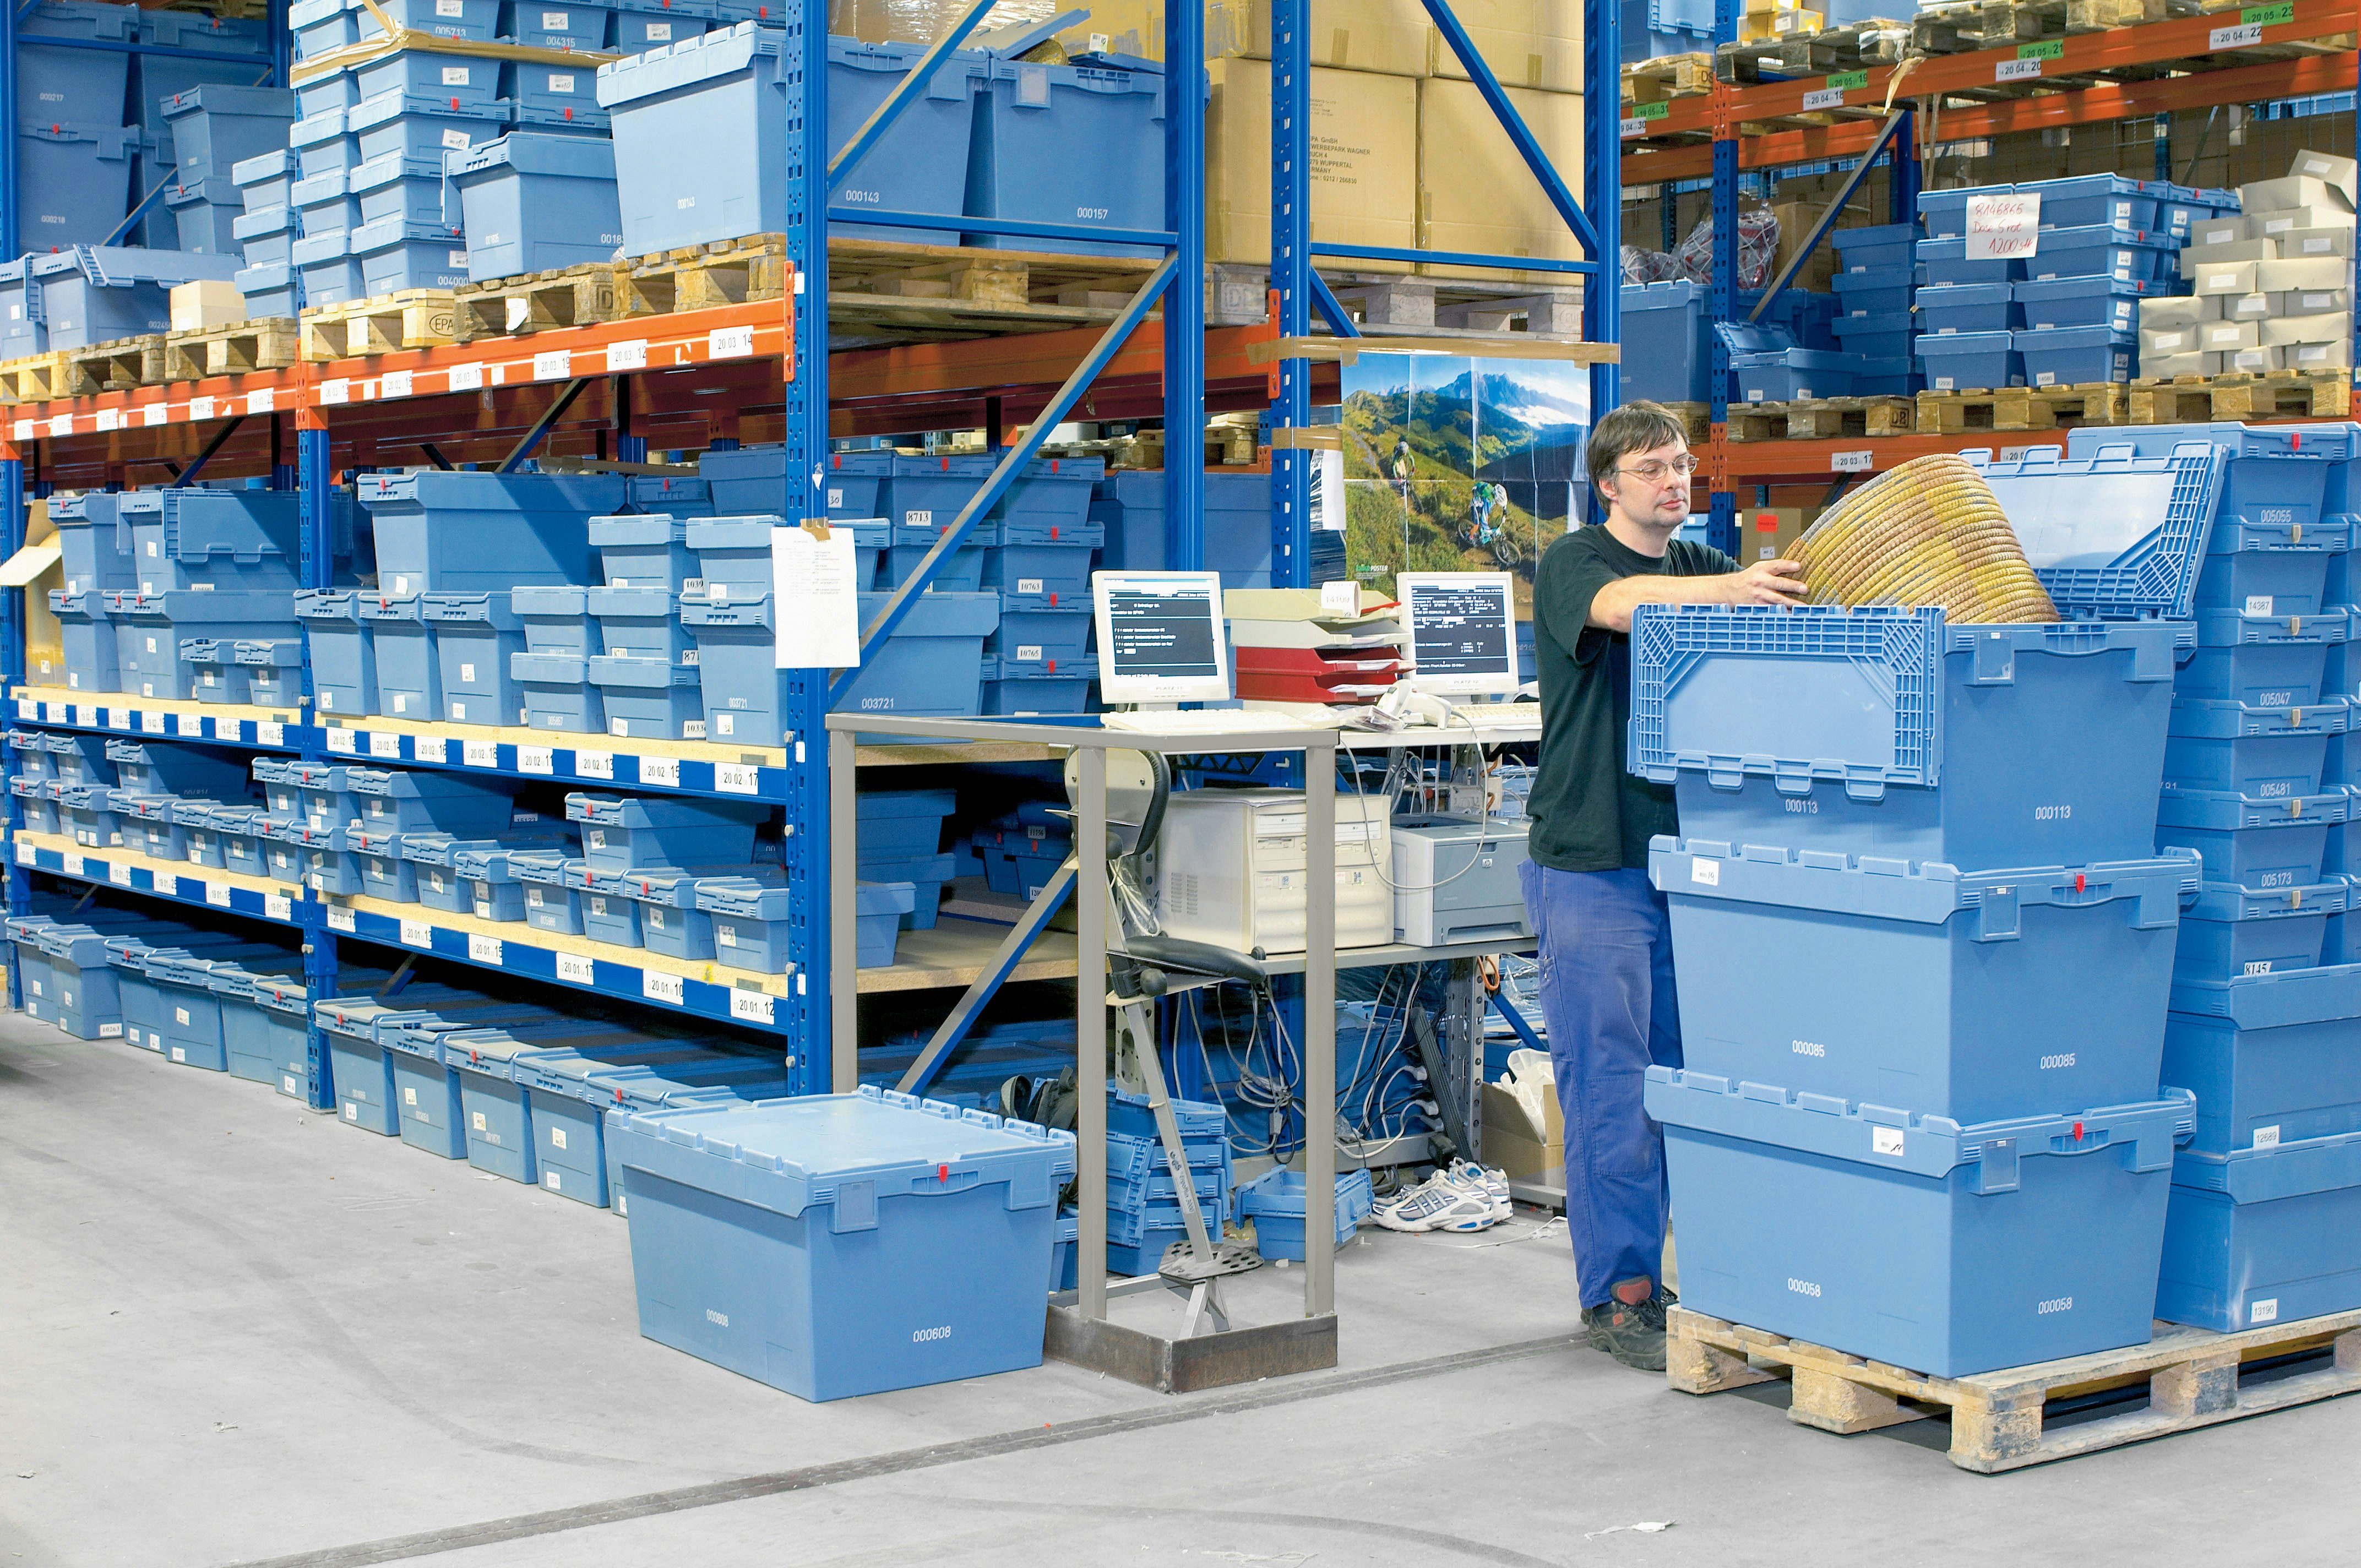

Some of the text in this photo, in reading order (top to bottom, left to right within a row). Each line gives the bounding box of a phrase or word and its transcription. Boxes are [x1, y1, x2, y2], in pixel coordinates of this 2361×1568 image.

[2251, 7, 2293, 22] 20 05 23
[2221, 34, 2230, 42] 20
[2233, 31, 2243, 40] 04
[2250, 26, 2261, 38] 22
[546, 36, 576, 47] 004315
[2027, 43, 2063, 58] 20 05 21
[2005, 61, 2041, 75] 20 04 20
[1811, 96, 1820, 105] 20
[1835, 90, 1844, 100] 18
[1661, 105, 1669, 114] 31
[1638, 120, 1646, 130] 30
[1311, 143, 1370, 155] WERBEPARK WAGNER
[1320, 159, 1353, 168] WUPPERTAL
[845, 190, 880, 203] 000143
[1077, 207, 1109, 220] 000157
[601, 233, 622, 244] 0018
[1989, 237, 2019, 254] 1200
[718, 333, 753, 350] 20 03 14
[616, 346, 646, 362] 20 03 12
[541, 356, 570, 372] 20 03 19
[1863, 454, 1873, 464] 17
[907, 511, 929, 523] 8713
[2261, 509, 2291, 522] 005055
[862, 698, 894, 710] 003721
[2260, 692, 2291, 706] 005047
[383, 741, 389, 750] 02
[421, 744, 427, 754] 20
[429, 745, 434, 755] 02
[471, 749, 477, 759] 20
[478, 749, 485, 759] 02
[526, 755, 532, 765] 20
[534, 756, 540, 766] 02
[584, 758, 613, 771] 20 02 13
[648, 765, 679, 778] 20 02 15
[724, 772, 758, 786] 20 02 17
[2260, 783, 2291, 797] 005481
[1785, 798, 1818, 814] 000113
[2035, 805, 2071, 820] 000113
[2261, 872, 2292, 887] 005173
[407, 928, 413, 938] 20
[414, 929, 420, 939] 01
[476, 944, 482, 954] 20
[483, 945, 489, 955] 01
[564, 962, 594, 977] 20 01 17
[2245, 963, 2267, 975] 8145
[652, 979, 683, 997] 20 01 10
[739, 999, 774, 1016] 20 01 12
[1792, 1039, 1825, 1058] 000085
[2040, 1053, 2076, 1070] 000085
[1788, 1277, 1821, 1298] 000058
[2038, 1296, 2072, 1315] 000058
[706, 1308, 729, 1327] 000608
[913, 1325, 951, 1342] 000608
